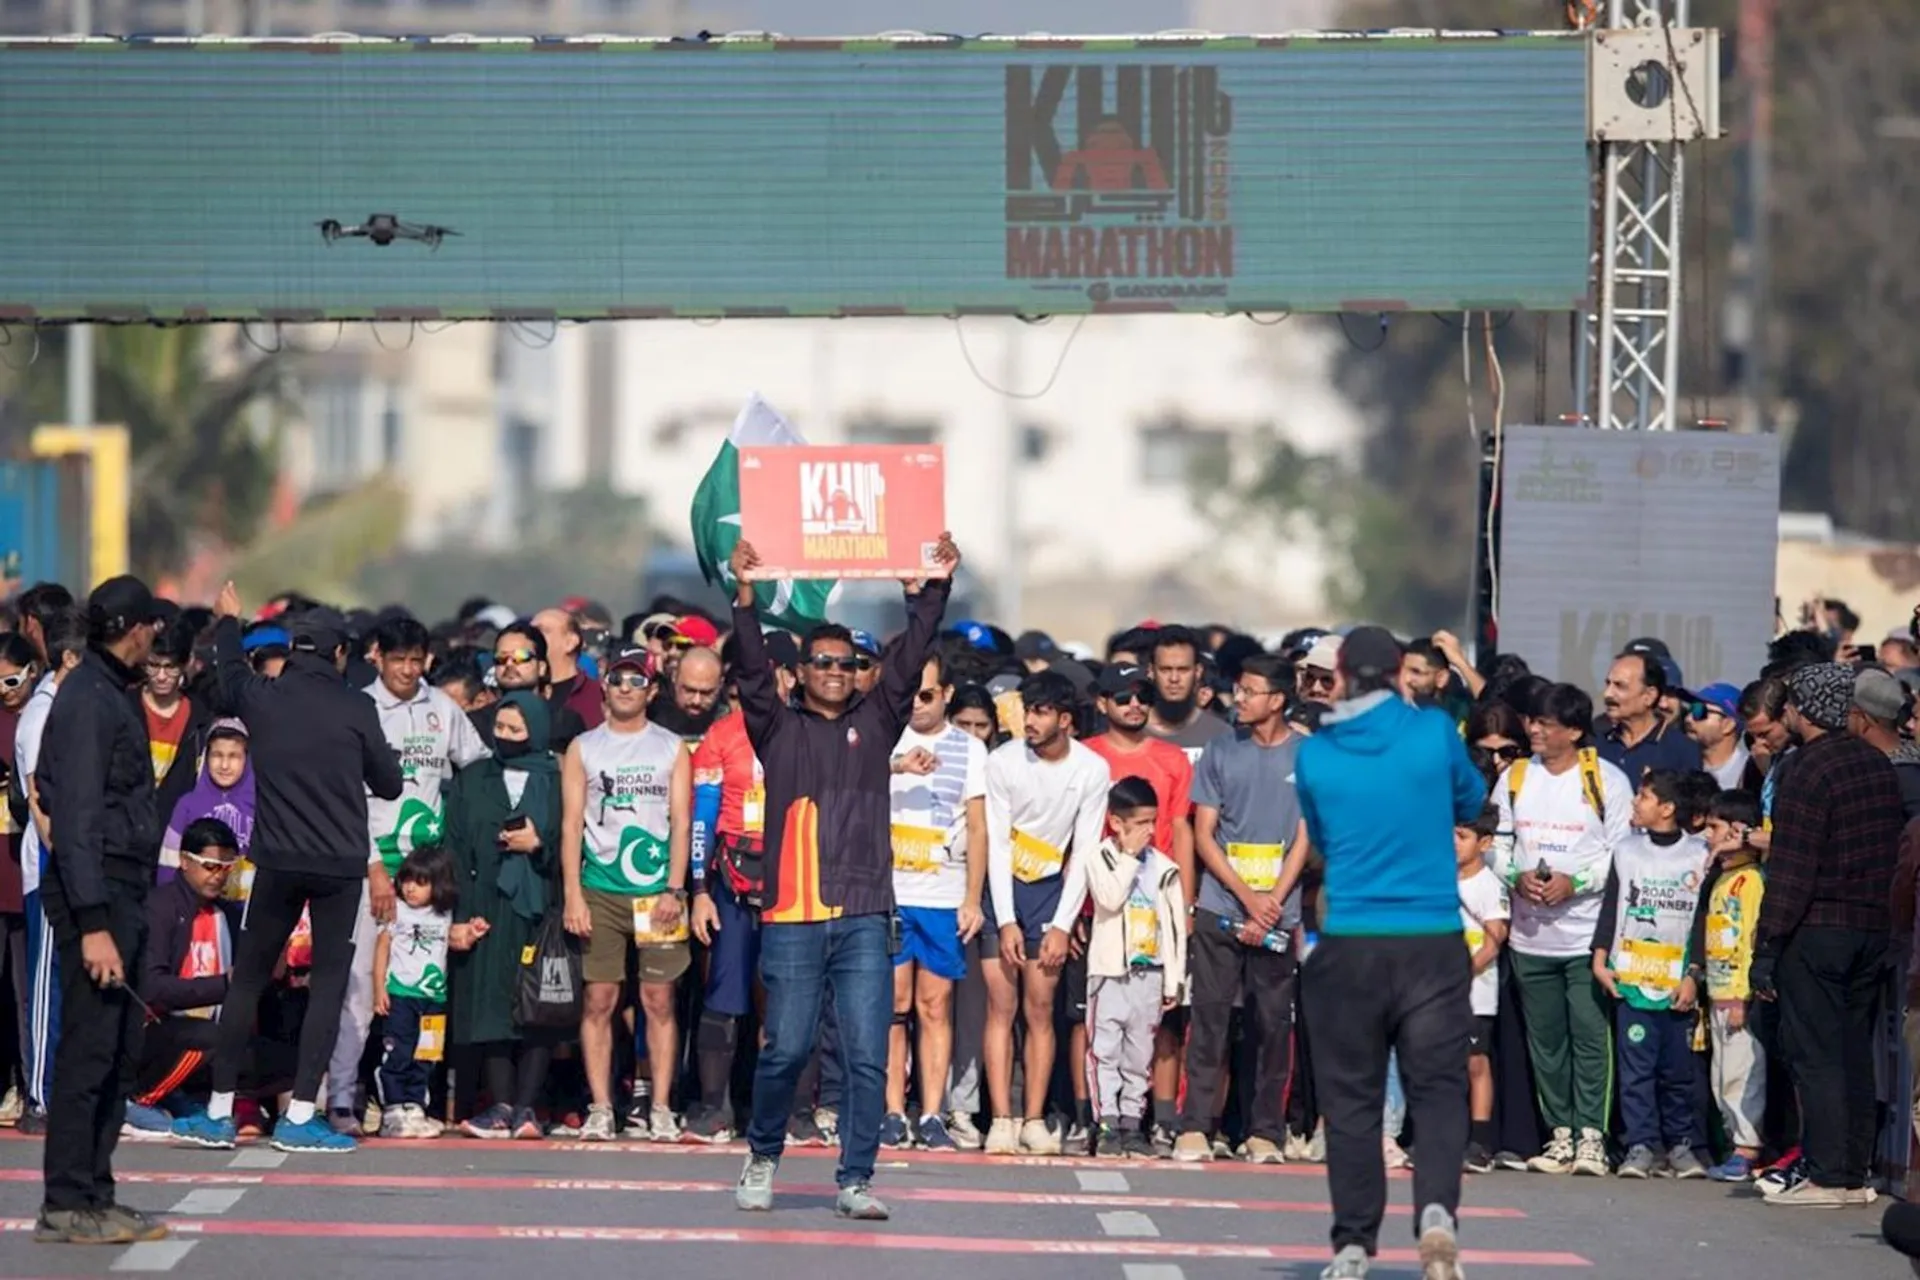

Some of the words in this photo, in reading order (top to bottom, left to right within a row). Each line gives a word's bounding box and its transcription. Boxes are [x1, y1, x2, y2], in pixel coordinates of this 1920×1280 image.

[1005, 226, 1234, 278] MARATHON
[803, 535, 888, 560] MARATHON
[617, 773, 652, 785] ROAD
[1642, 886, 1675, 899] ROAD
[1641, 898, 1693, 912] RUNNERS
